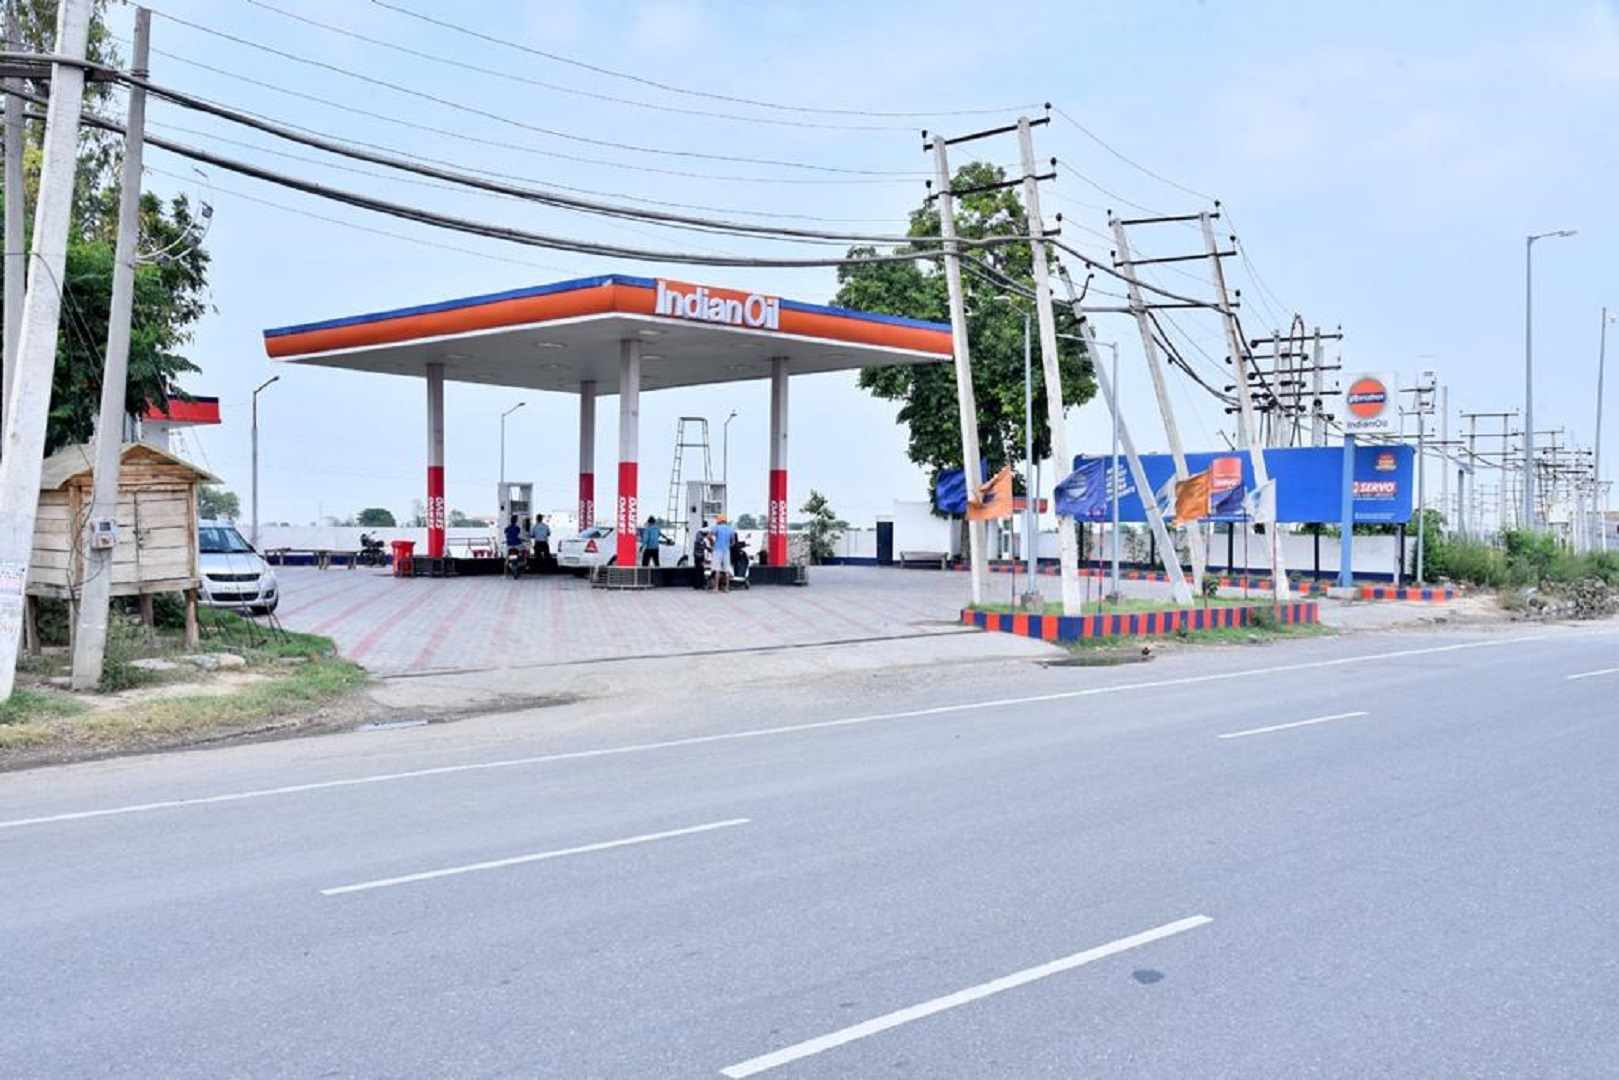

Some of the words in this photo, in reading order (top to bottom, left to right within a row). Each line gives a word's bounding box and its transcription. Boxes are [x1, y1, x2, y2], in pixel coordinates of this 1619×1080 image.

[1359, 481, 1395, 493] SERVO
[436, 496, 444, 530] SERVO
[628, 496, 637, 535] SERVO
